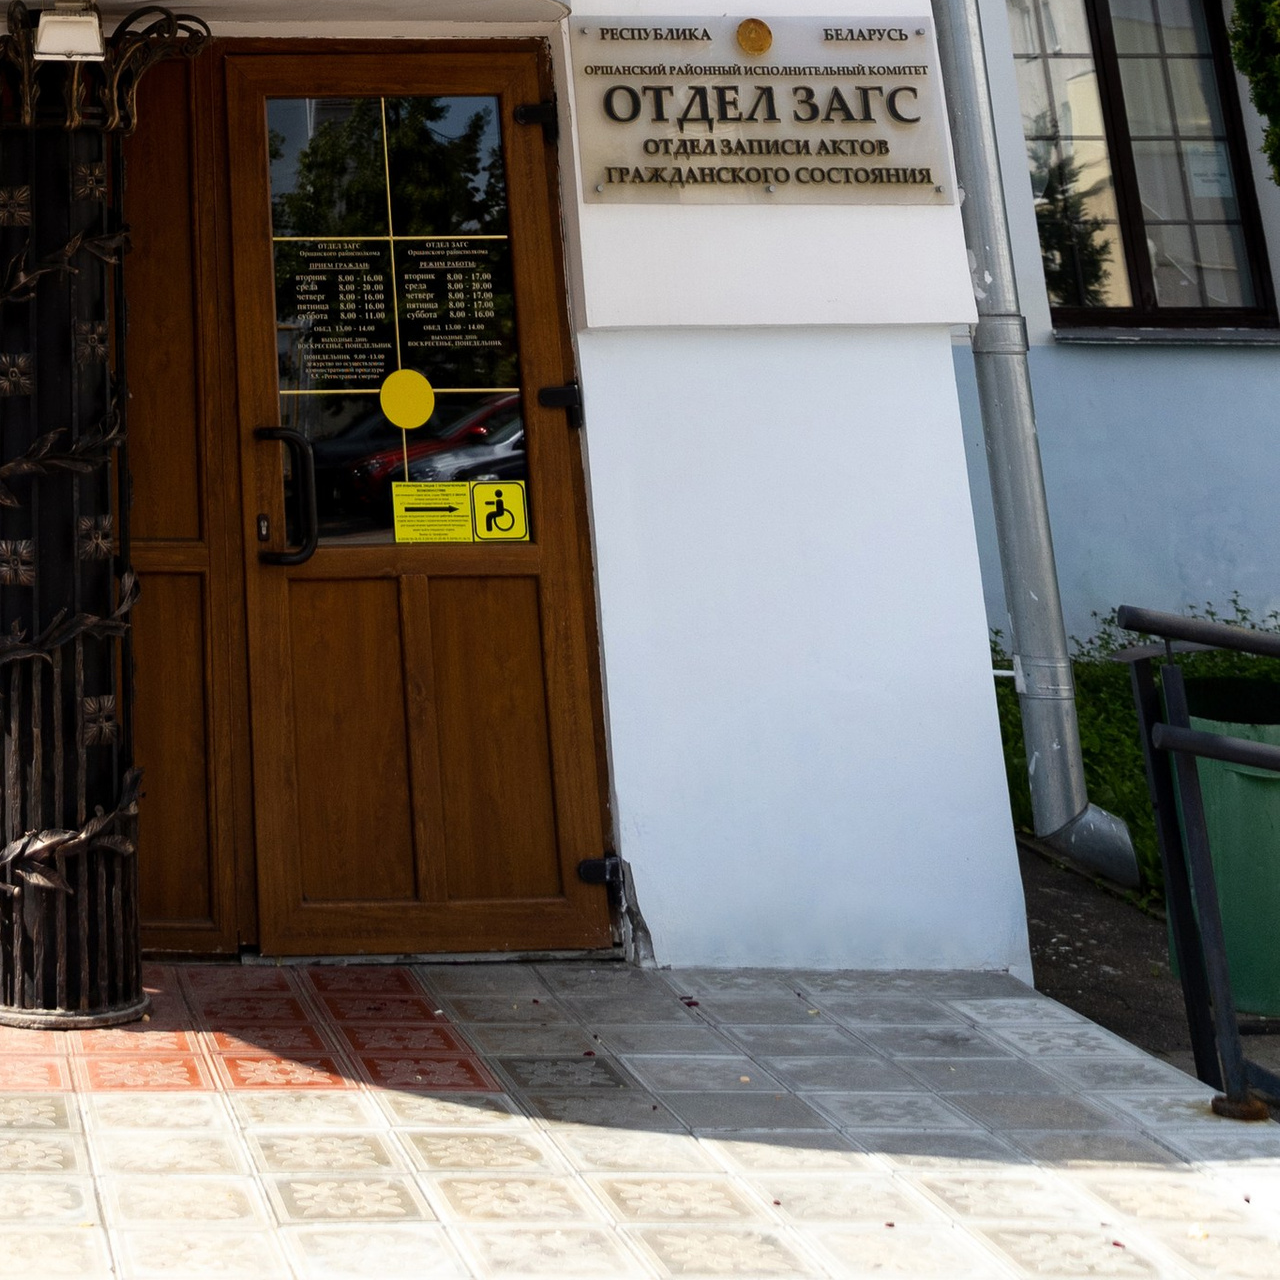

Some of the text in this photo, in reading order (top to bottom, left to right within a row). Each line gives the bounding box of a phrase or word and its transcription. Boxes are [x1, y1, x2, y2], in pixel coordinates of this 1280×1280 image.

[599, 27, 909, 42] РЕСПУБЛИКА БЕЛАРУСЬ
[584, 63, 929, 76] ОРШАНСКИЙ РАЙОННЫЙ ИСПОЛНИТЕЛЬНЫЙ КОМИТЕТ
[603, 85, 922, 133] ОТДЕЛ ЗАГС
[643, 139, 890, 160] ОТДЕЛ ЗАПИСИ АКТОВ
[605, 166, 933, 187] ГРАЖДАНСКОГО СОСТОЯНИЯ
[296, 284, 318, 292] среда
[297, 312, 328, 321] суббота
[407, 311, 437, 320] суббота
